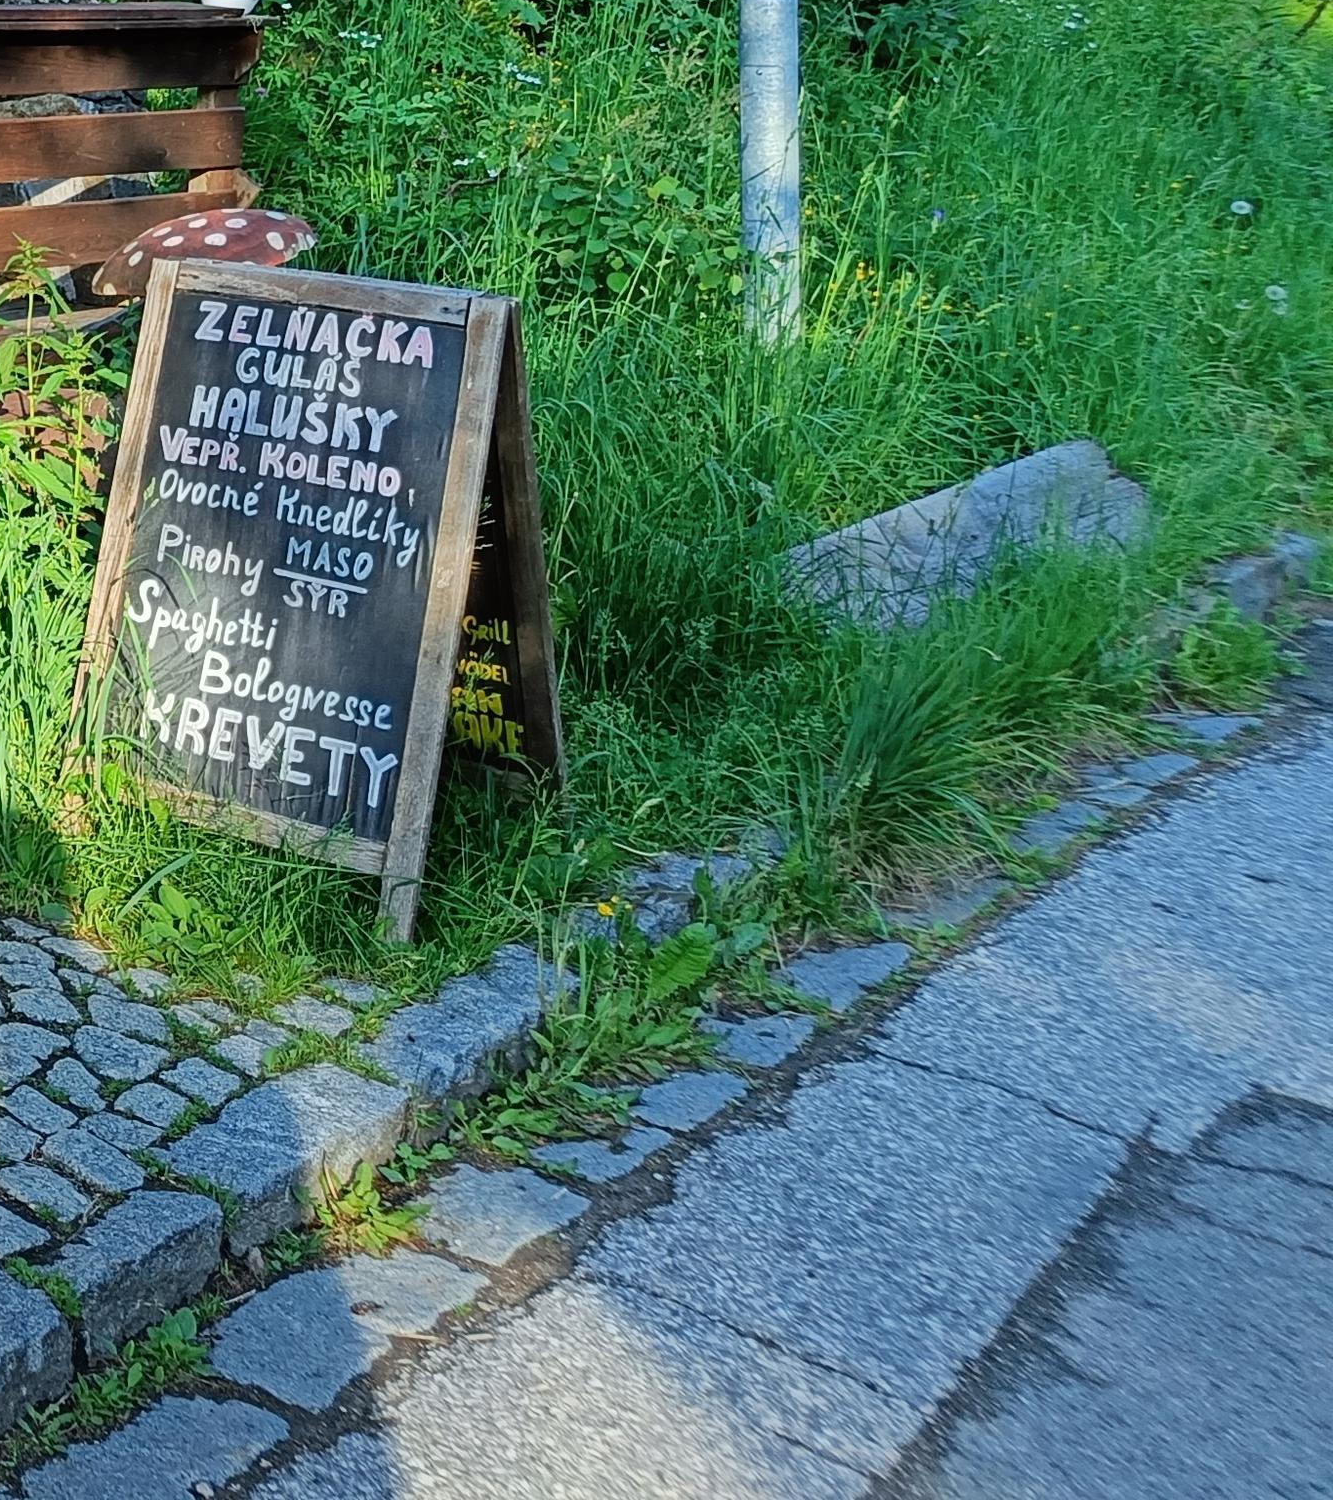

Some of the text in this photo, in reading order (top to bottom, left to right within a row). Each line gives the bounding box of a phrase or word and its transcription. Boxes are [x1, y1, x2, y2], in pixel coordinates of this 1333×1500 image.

[189, 385, 399, 452] HALUŠKY
[160, 424, 402, 497] VEPŘ. KOLENO
[159, 468, 264, 517] Ovocné
[277, 484, 420, 568] Knedlíky
[286, 536, 374, 581] MASO
[128, 578, 279, 653] Spaghetti
[140, 690, 399, 809] KREVETY
